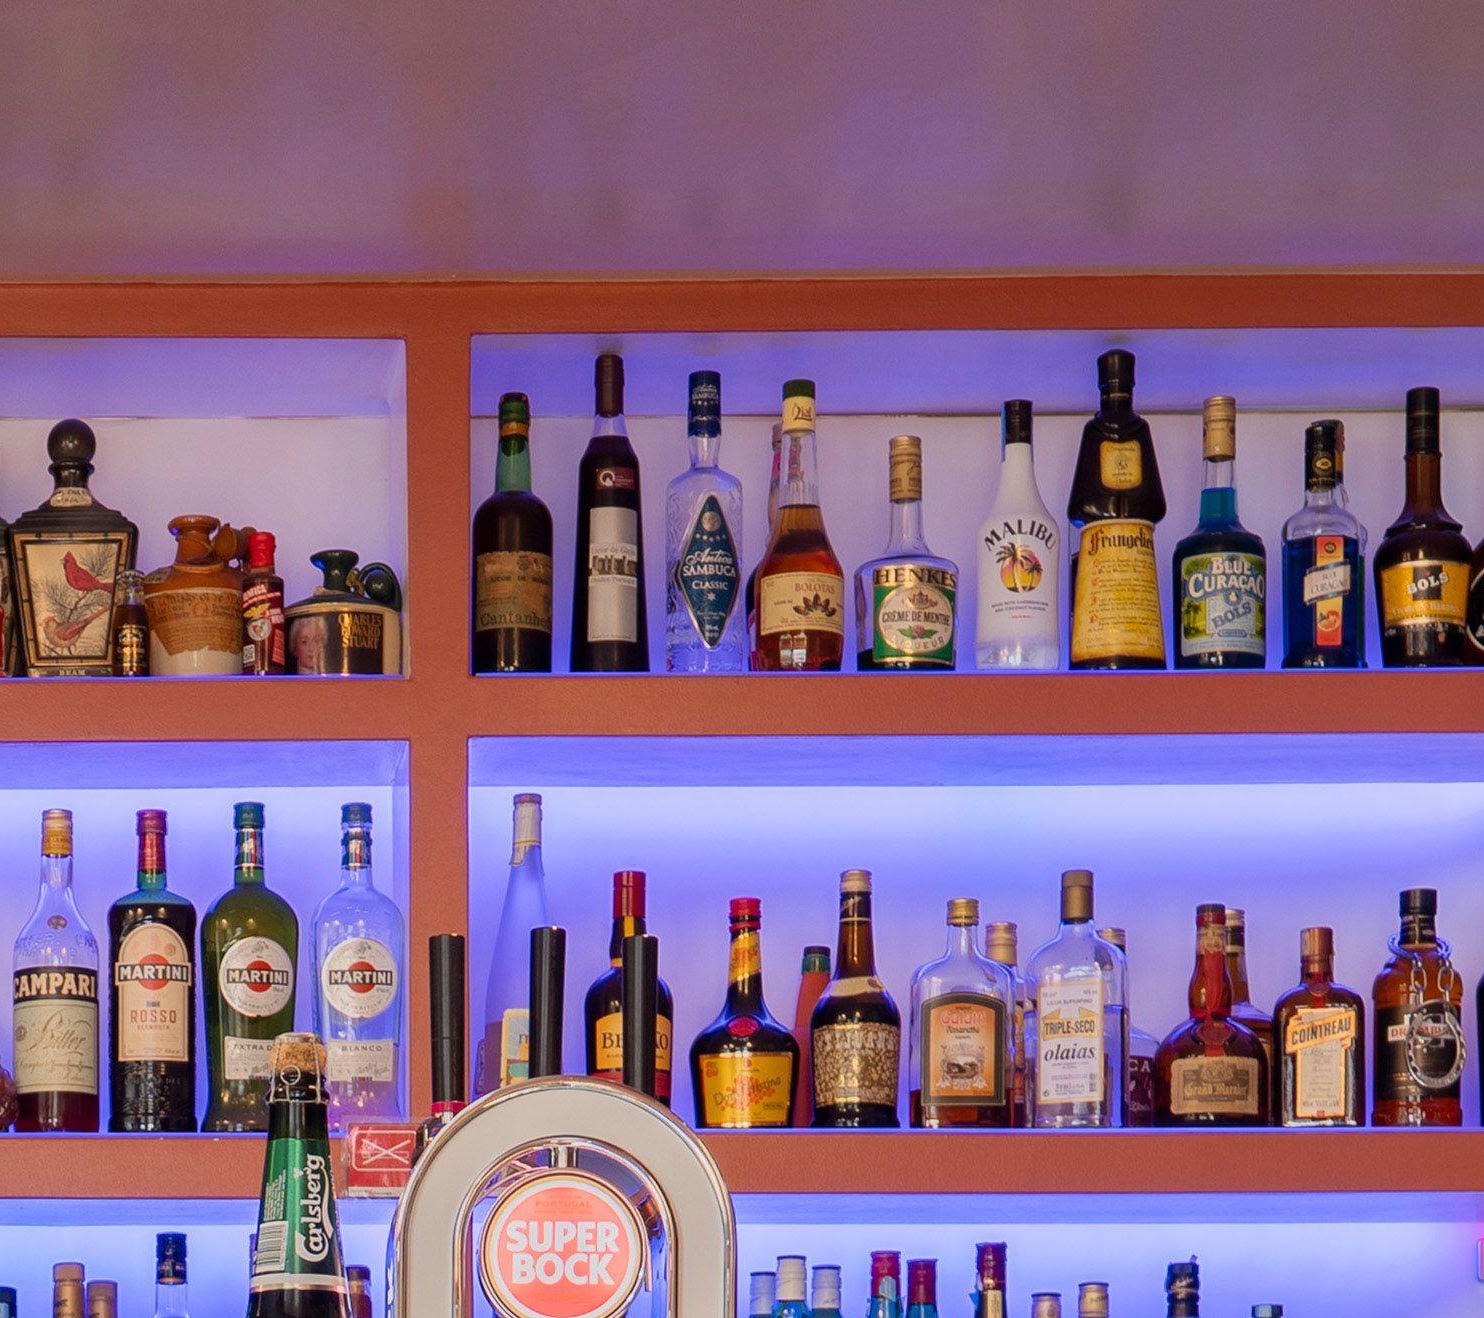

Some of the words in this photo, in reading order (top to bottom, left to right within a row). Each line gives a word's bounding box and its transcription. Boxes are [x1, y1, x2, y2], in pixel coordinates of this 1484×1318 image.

[983, 518, 1056, 552] MALIBU
[682, 565, 735, 576] SAMBUCA
[1211, 558, 1251, 575] BLUE
[692, 580, 729, 590] CLASSIC
[874, 567, 957, 589] HENKES
[1187, 574, 1265, 598] CURAÇAO
[1407, 572, 1449, 594] BOLS
[1212, 603, 1252, 629] BOLS
[342, 636, 378, 649] STUART
[118, 965, 188, 981] MARTINI
[229, 970, 289, 985] MARTINI
[331, 970, 393, 985] MARTINI
[13, 972, 96, 998] CAMPARI
[130, 1010, 177, 1024] ROSSO
[1044, 1020, 1095, 1035] TRIPLE-SECO
[1290, 1017, 1351, 1045] COINTREAU
[341, 1045, 383, 1053] BIANCO
[1045, 1044, 1096, 1062] olaias
[295, 1154, 334, 1262] Carlsberg
[505, 1221, 620, 1254] SUPER
[511, 1253, 615, 1285] BOCK
